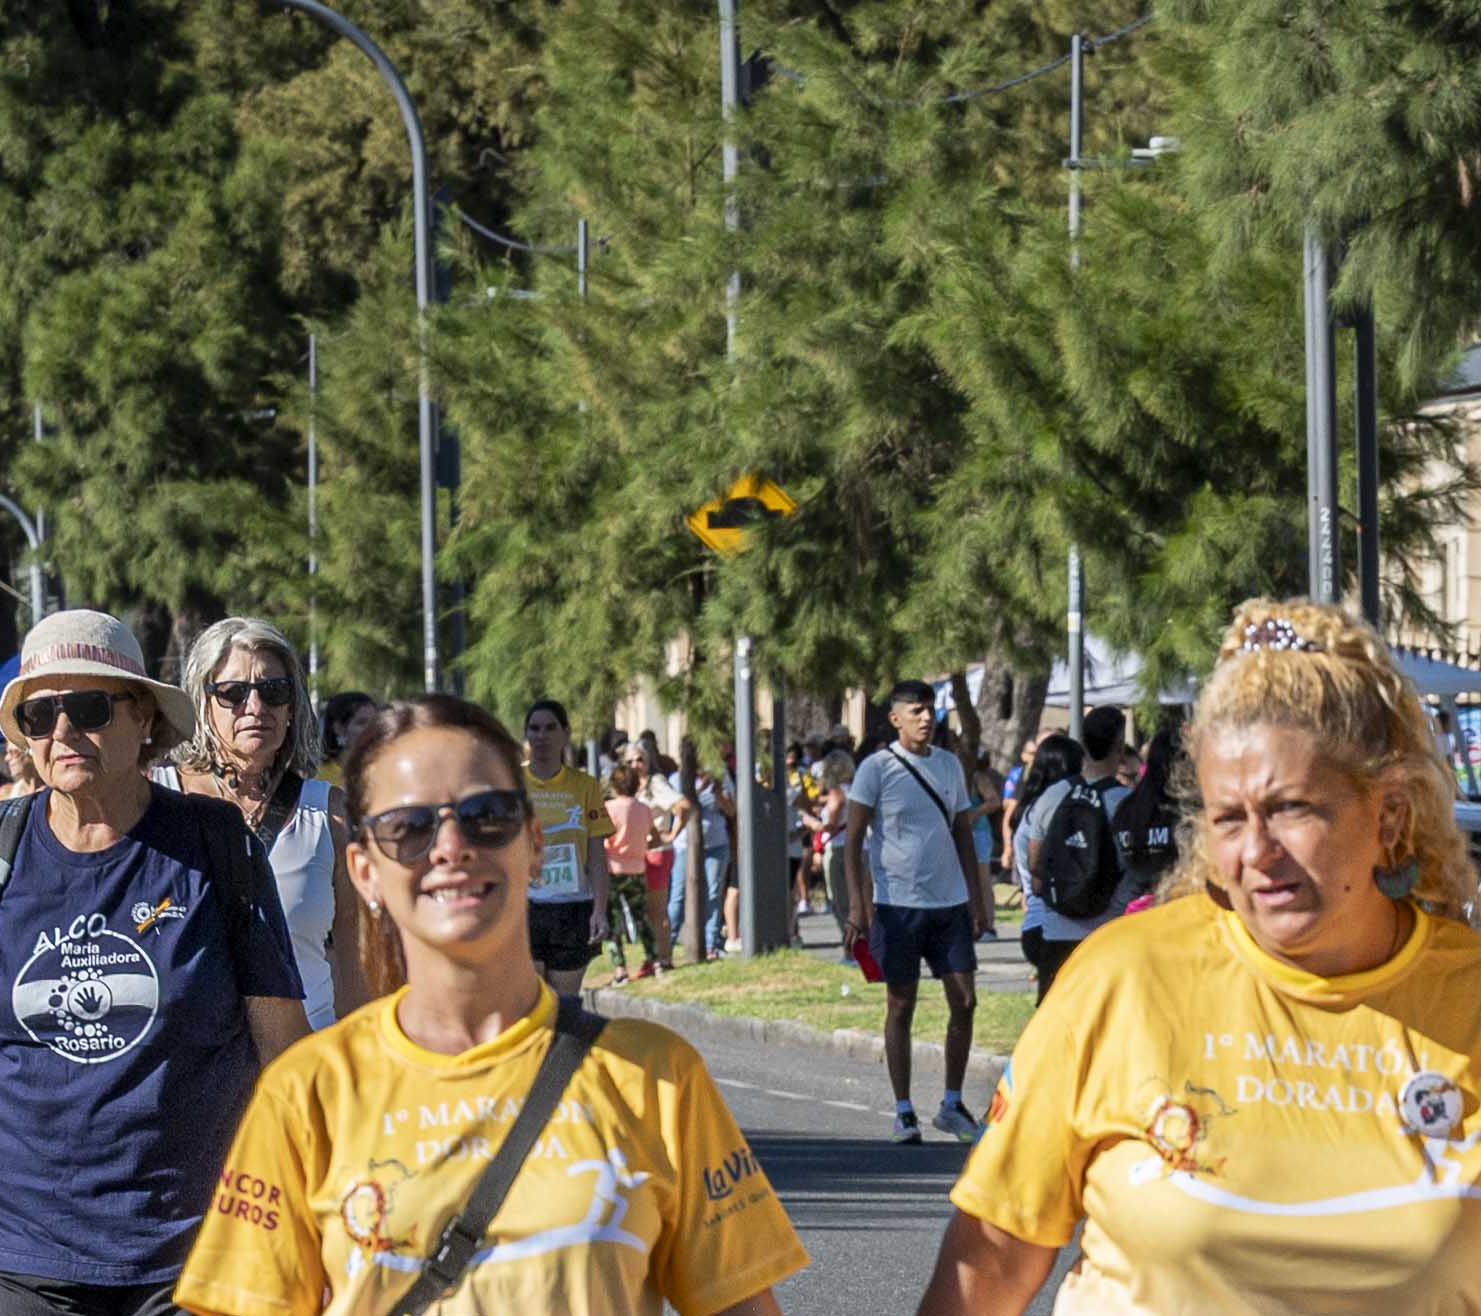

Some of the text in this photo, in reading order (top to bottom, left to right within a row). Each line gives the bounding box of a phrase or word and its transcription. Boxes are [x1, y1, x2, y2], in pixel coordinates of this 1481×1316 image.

[33, 913, 107, 954] ALCO
[61, 951, 140, 968] Auxiliadora
[55, 1034, 126, 1051] Rosario
[1235, 1075, 1400, 1115] DORADA
[416, 1136, 567, 1166] DORDA
